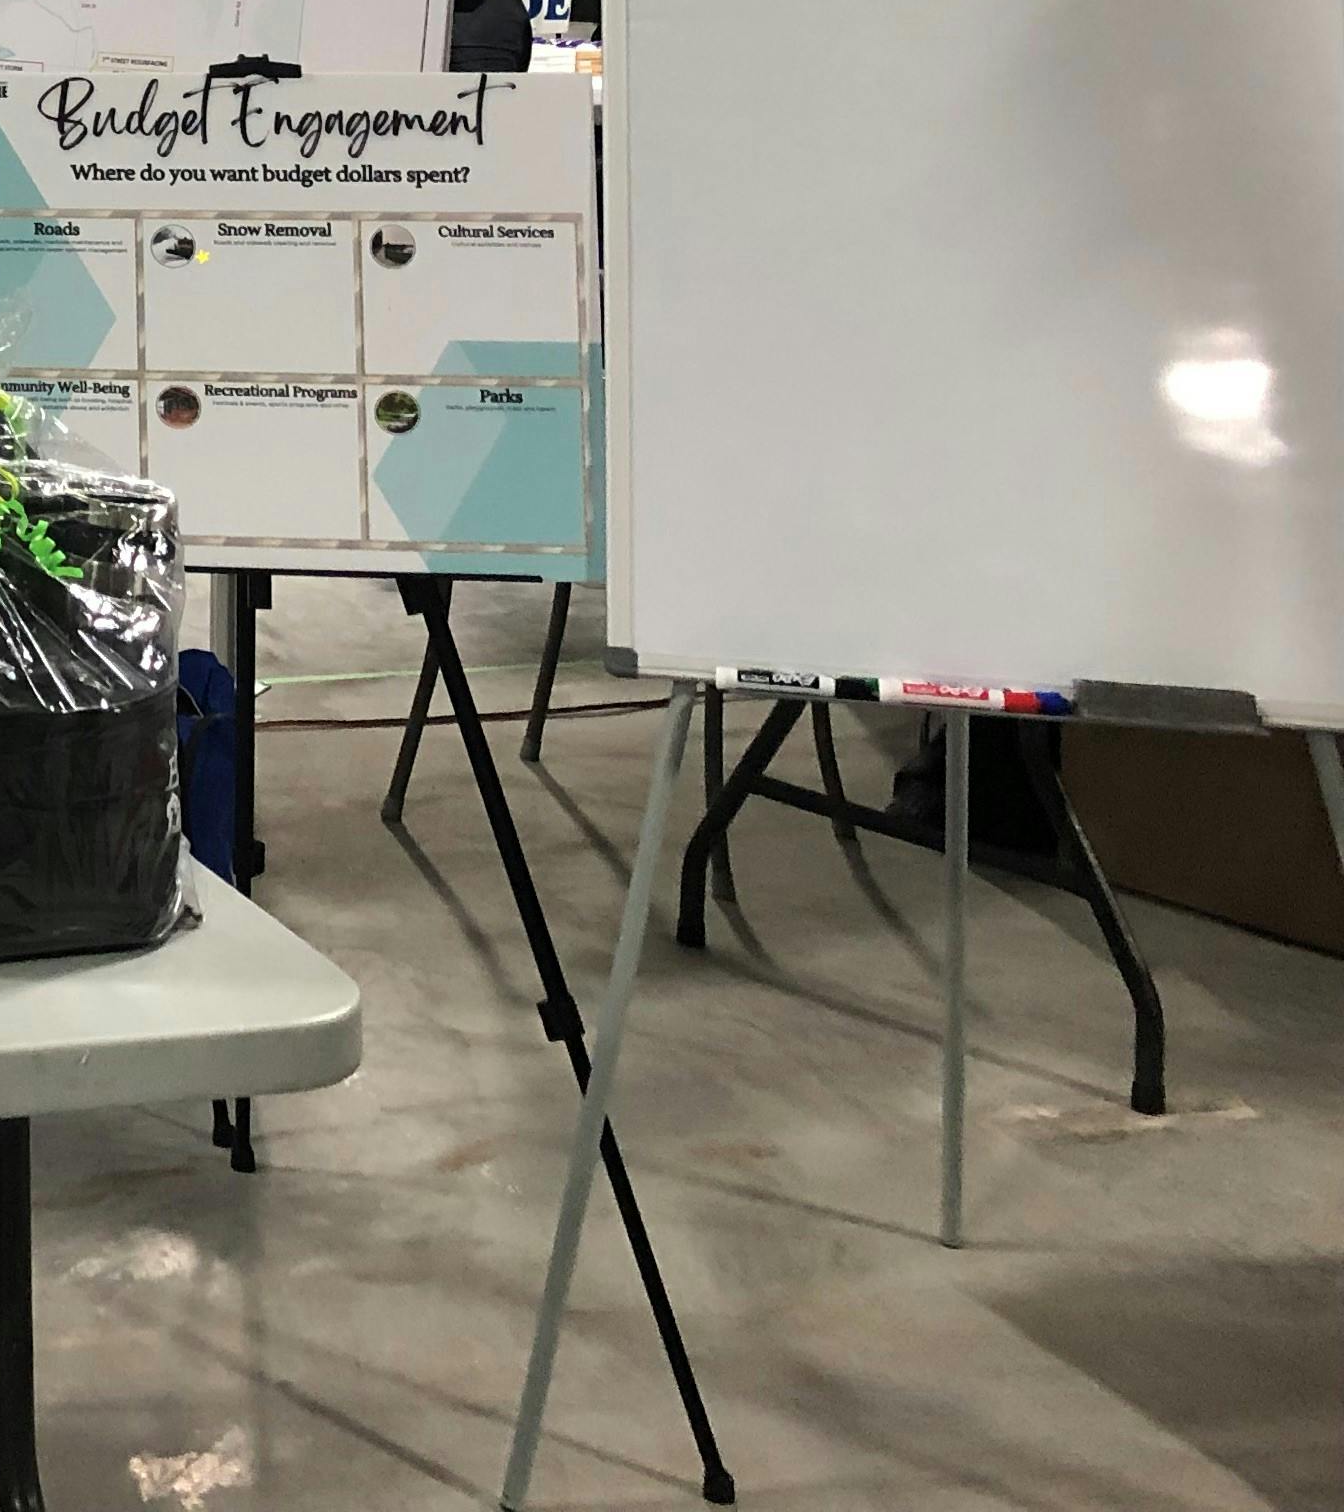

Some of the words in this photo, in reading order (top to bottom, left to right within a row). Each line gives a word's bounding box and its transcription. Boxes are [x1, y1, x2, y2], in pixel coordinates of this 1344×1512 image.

[36, 75, 220, 158] Budget
[230, 75, 516, 158] Engagement
[70, 163, 135, 183] Where
[140, 164, 165, 183] do
[168, 168, 206, 188] you
[211, 168, 258, 185] want
[262, 163, 332, 187] budget
[335, 164, 403, 185] dollars
[406, 165, 471, 189] spent?
[33, 222, 80, 237] Roads
[217, 222, 260, 237] Snow
[264, 223, 332, 238] Removal
[437, 224, 495, 239] Cultural
[497, 225, 555, 240] Services
[57, 379, 130, 397] Well-Being
[204, 384, 289, 400] Recreational
[293, 385, 358, 403] Programs
[479, 388, 523, 405] Parks
